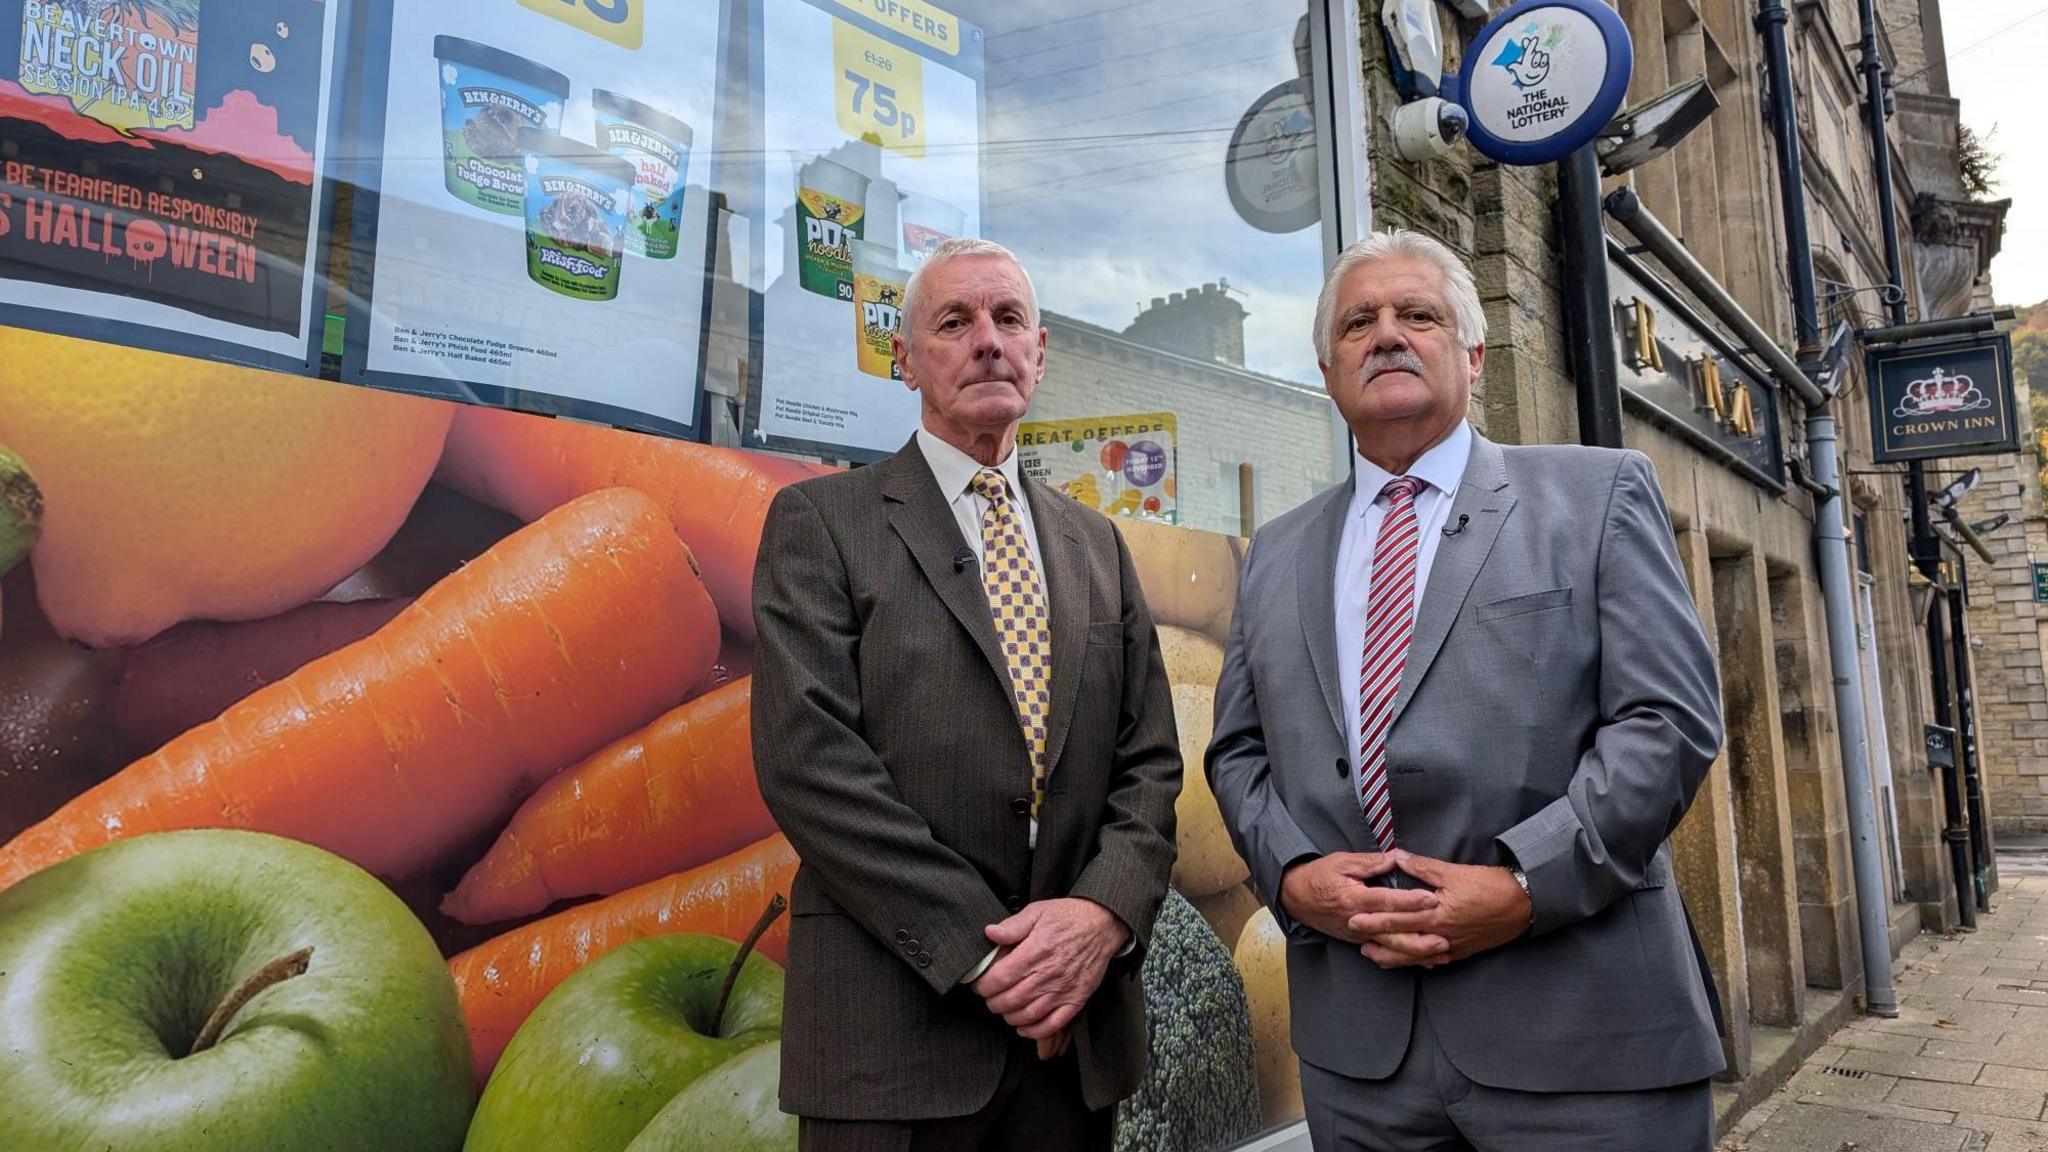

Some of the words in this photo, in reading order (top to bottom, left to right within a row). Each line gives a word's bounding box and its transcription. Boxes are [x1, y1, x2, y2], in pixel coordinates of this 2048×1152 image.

[25, 0, 193, 64] BEAVERTOWN
[875, 0, 948, 41] OFFERS
[24, 21, 126, 85] NECK
[137, 52, 191, 105] OIL
[24, 63, 103, 101] SESSION
[111, 85, 141, 111] IPA
[1523, 89, 1547, 103] THE
[844, 70, 916, 138] 75p
[1507, 96, 1569, 120] NATIONAL
[1512, 107, 1566, 129] LOTTERY
[469, 159, 523, 182] Chocolat
[6, 160, 36, 189] BE
[39, 168, 142, 209] TERRIFIED
[148, 191, 258, 239] RESPONSIBLY
[491, 179, 524, 194] Brow
[25, 197, 257, 283] HALLOWEEN
[805, 216, 857, 252] POT
[862, 301, 902, 331] PO
[393, 335, 409, 343] Ben
[419, 339, 446, 350] Jerry's
[448, 343, 469, 352] Phish
[470, 346, 487, 355] Food
[489, 349, 512, 359] 465ml
[394, 327, 410, 335] Ben
[420, 330, 447, 341] Jerry's
[448, 334, 485, 346] Chocolate
[486, 340, 507, 350] Fudge
[508, 344, 535, 354] Brownie
[536, 348, 558, 358] 465ml
[418, 348, 445, 358] Jerry's
[447, 351, 463, 360] Half
[465, 354, 487, 363] Baked
[488, 358, 512, 367] 465ml
[1893, 420, 1958, 436] CROWN
[1964, 416, 1996, 430] INN
